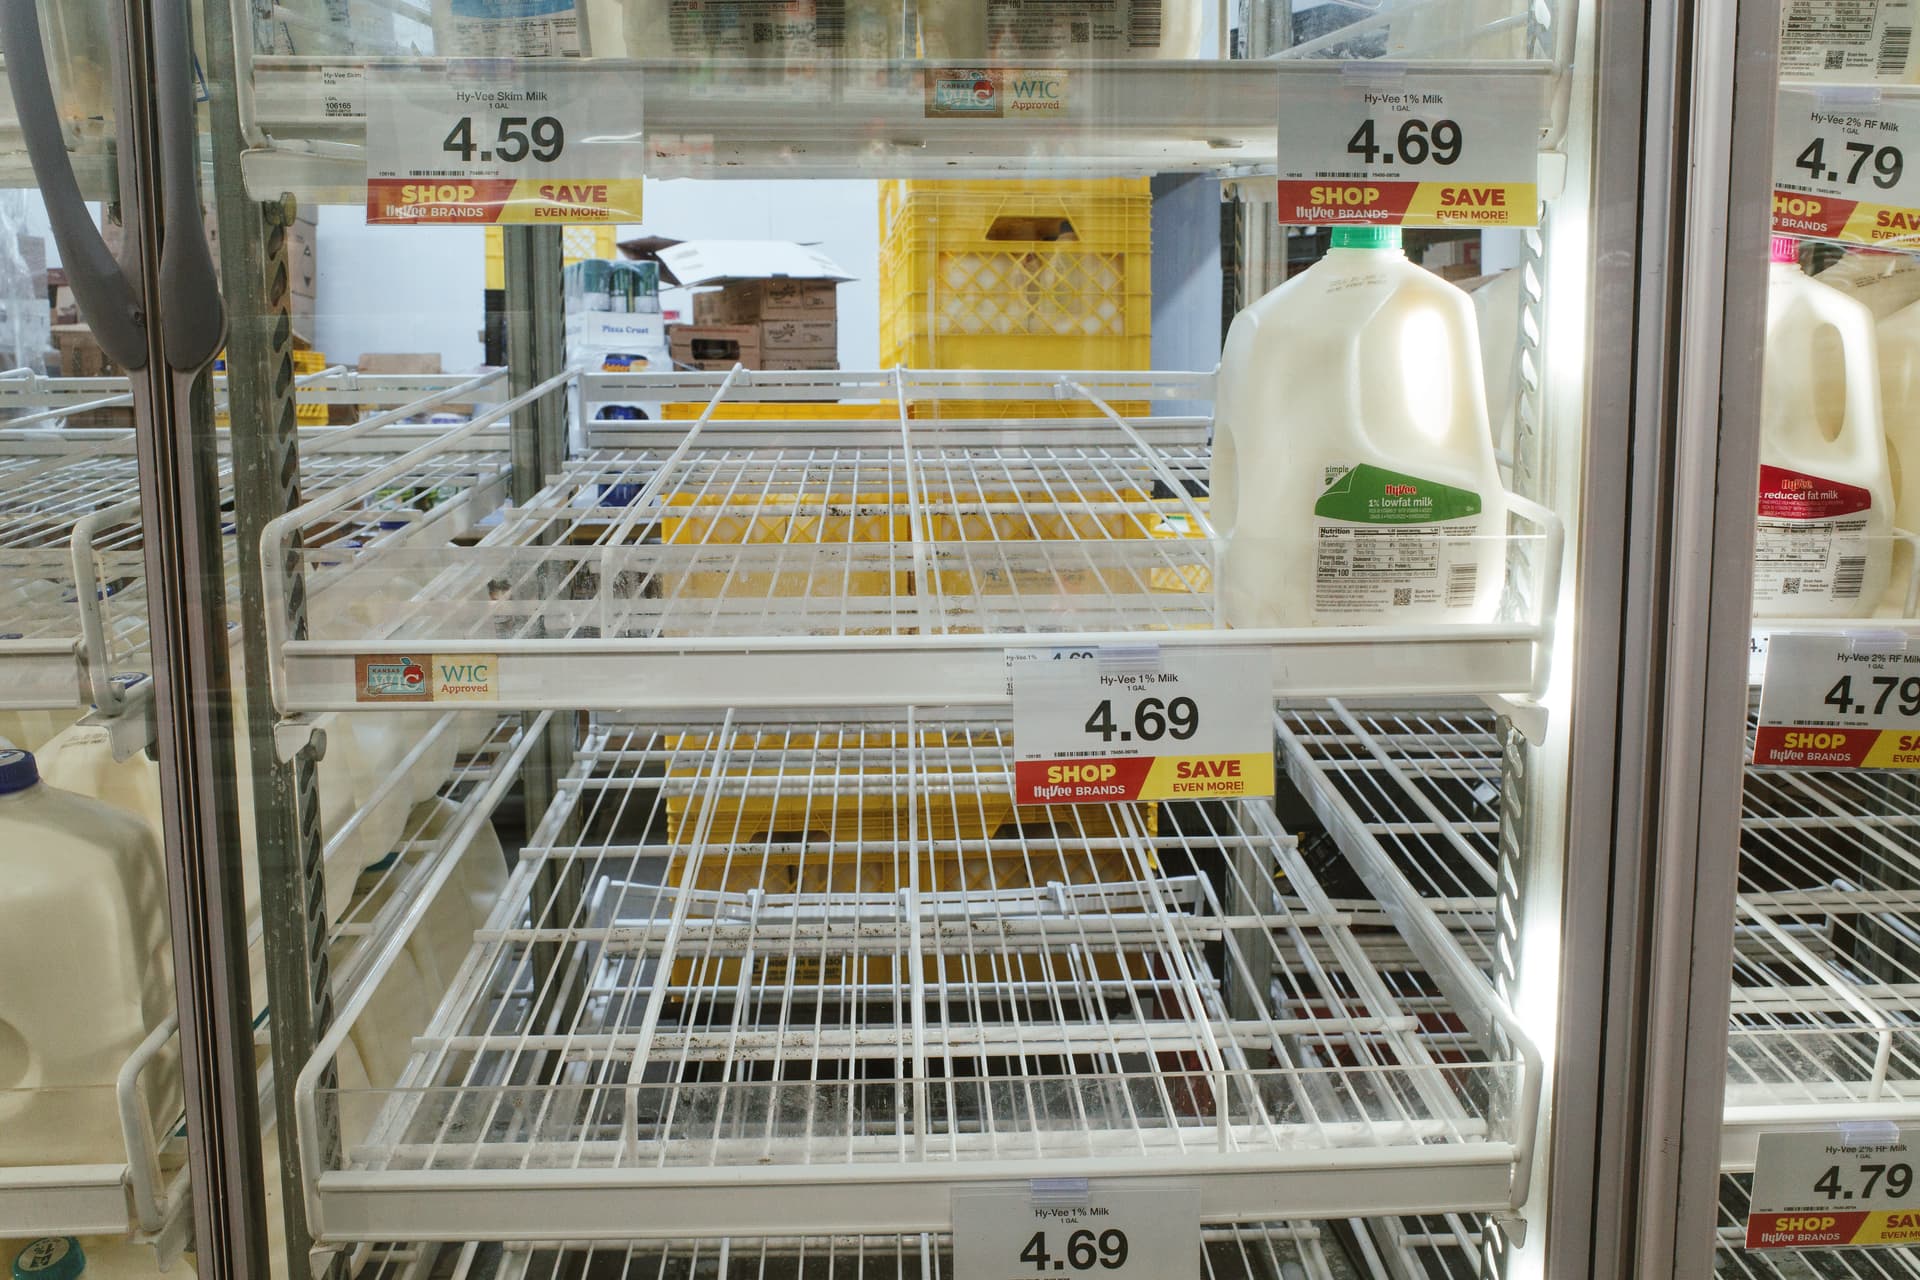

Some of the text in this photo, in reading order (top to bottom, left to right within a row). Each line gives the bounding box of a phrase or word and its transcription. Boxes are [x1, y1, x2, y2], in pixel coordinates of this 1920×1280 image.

[1013, 80, 1060, 99] WIC
[456, 91, 548, 104] Hy-Vee Skim Milk
[943, 90, 990, 106] WIC
[1364, 94, 1443, 106] Hy-Vee 1% Milk
[1011, 101, 1060, 110] Approved
[1811, 112, 1899, 132] Hy-Vee 2% RF Milk
[443, 116, 565, 162] 4.59
[1347, 119, 1463, 165] 4.69
[1796, 137, 1904, 189] 4.79
[402, 184, 475, 203] SHOP
[540, 184, 607, 203] SAVE
[1310, 186, 1380, 206] SHOP
[1440, 188, 1505, 206] SAVE
[431, 207, 484, 217] BRANDS
[535, 207, 609, 217] EVEN MORE!
[1296, 206, 1388, 220] HyVee BRANDS
[1773, 195, 1822, 217] HOP
[1436, 210, 1508, 220] EVEN MORE!
[1876, 210, 1920, 231] SAV
[1782, 217, 1828, 232] BRANDS
[602, 325, 649, 334] Pizza Crust
[1325, 465, 1349, 477] simple
[1385, 484, 1417, 496] HyVee
[1781, 479, 1814, 491] HyVee
[1368, 497, 1433, 507] 1% lowfat milk
[1764, 490, 1838, 500] reduced fat milk
[1338, 569, 1349, 577] 100
[1837, 653, 1869, 662] Hy-Vee
[1871, 653, 1886, 662] 2%
[1888, 654, 1902, 662] RF
[441, 665, 488, 682] WIC
[1100, 673, 1178, 686] Hy-Vee 1% Milk
[372, 673, 420, 690] WIC
[441, 684, 488, 694] Approved
[1824, 675, 1920, 716] 4.79
[1085, 696, 1199, 742] 4.69
[1784, 732, 1846, 749] SHOP
[1898, 735, 1920, 751] SA
[1769, 749, 1852, 763] HyVee BRANDS
[1047, 764, 1117, 784] SHOP
[1177, 760, 1241, 779] SAVE
[1033, 785, 1126, 799] HyVee BRANDS
[1173, 781, 1244, 793] EVEN MORE!
[1825, 1145, 1857, 1155] Hy-Vee
[1890, 1144, 1908, 1152] Milk
[1814, 1163, 1913, 1200] 4.79
[1035, 1207, 1110, 1219] Hy-Vee 1% Milk
[1776, 1216, 1836, 1231] SHOP
[1886, 1214, 1920, 1229] SAV
[1761, 1232, 1841, 1244] HyVee BRANDS
[1881, 1231, 1907, 1239] EVEN
[1020, 1229, 1129, 1271] 4.69
